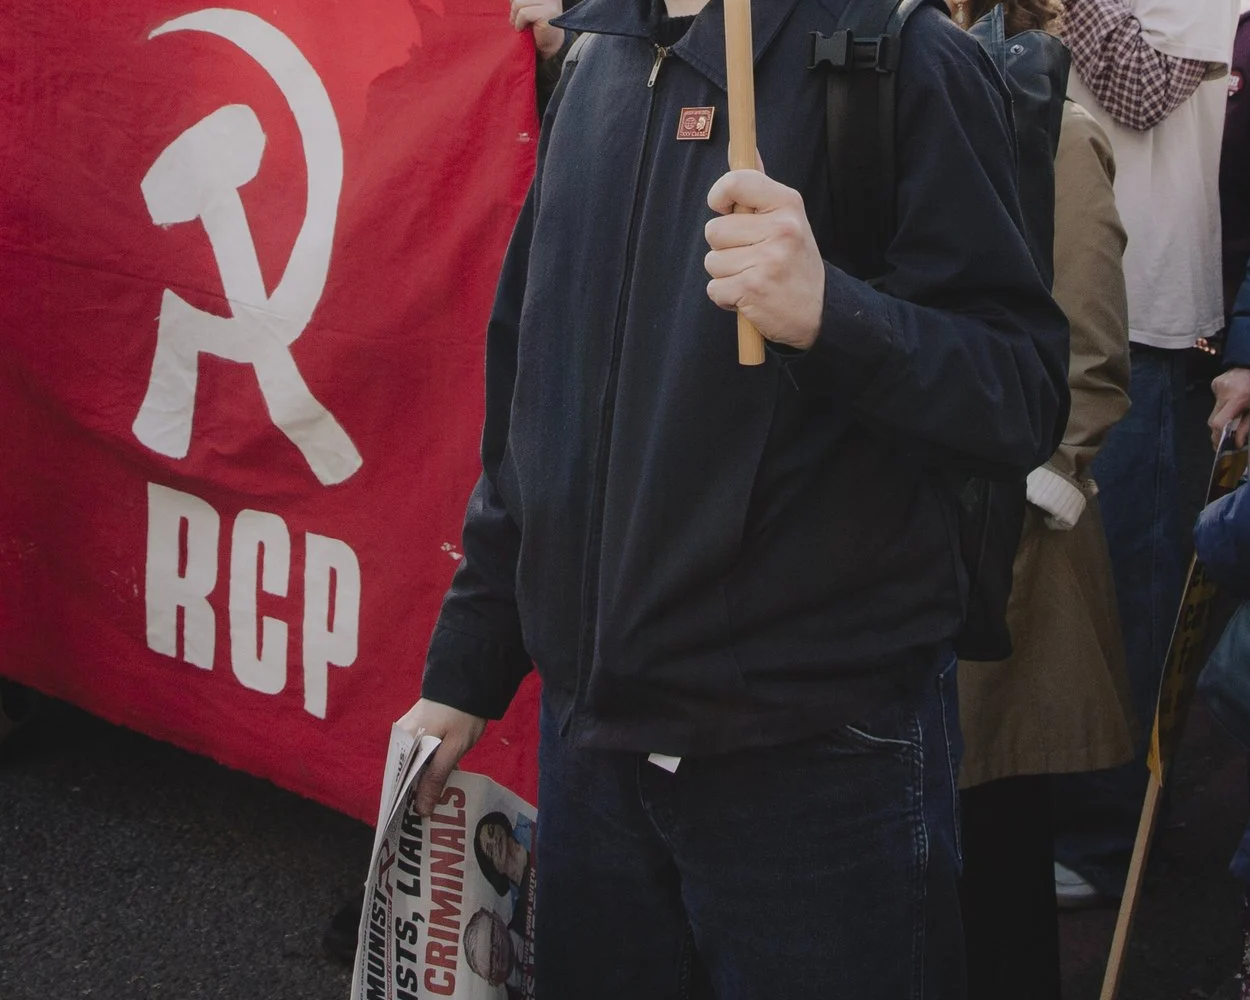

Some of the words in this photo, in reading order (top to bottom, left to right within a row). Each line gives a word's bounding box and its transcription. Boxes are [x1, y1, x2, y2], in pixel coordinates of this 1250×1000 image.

[145, 481, 361, 720] RCP
[366, 883, 388, 1000] MUNIST
[394, 909, 426, 1000] ISTS,
[423, 786, 467, 997] CRIMINALS
